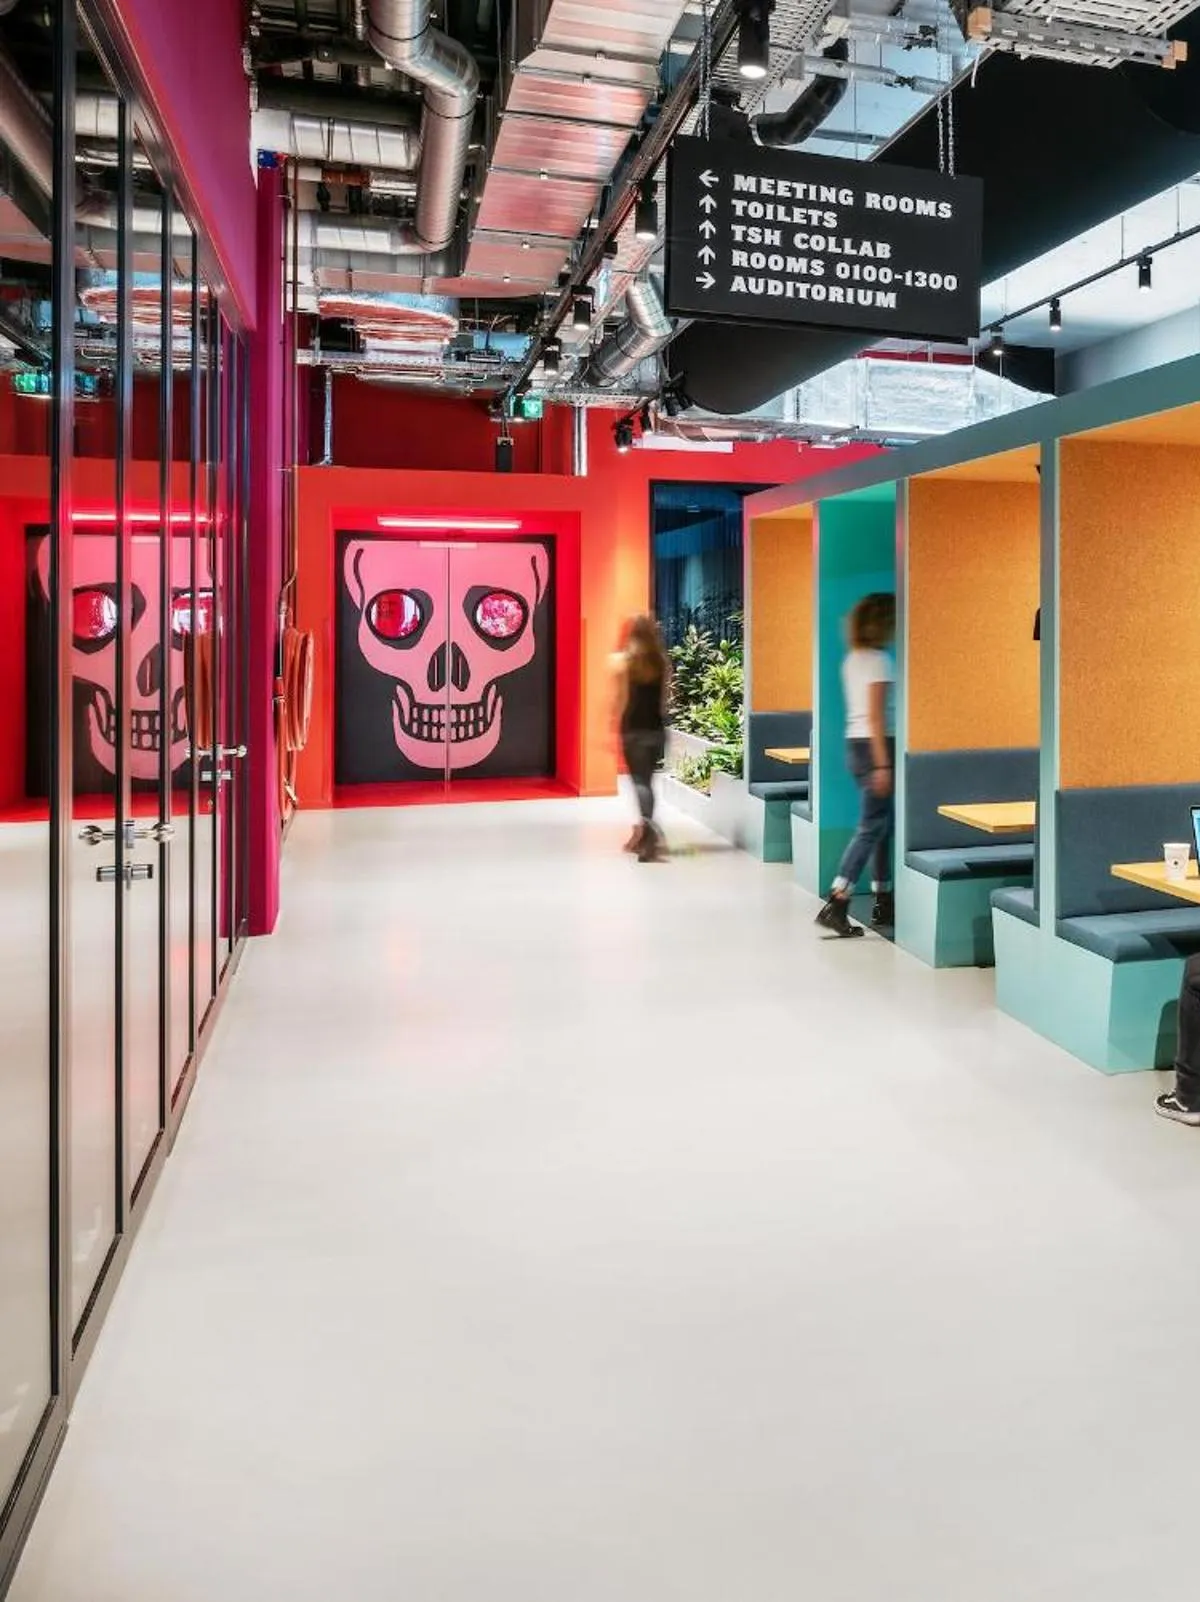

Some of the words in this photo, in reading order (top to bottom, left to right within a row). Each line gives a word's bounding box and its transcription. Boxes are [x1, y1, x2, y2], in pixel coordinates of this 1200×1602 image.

[730, 198, 838, 229] TOILETS
[733, 174, 854, 206] MEETING
[865, 191, 953, 219] ROOMS
[730, 223, 782, 247] TSH
[793, 232, 892, 259] COLLAB
[731, 249, 825, 277] ROOMS
[835, 261, 958, 292] 0100-1300
[729, 275, 897, 309] AUDITORIUM
